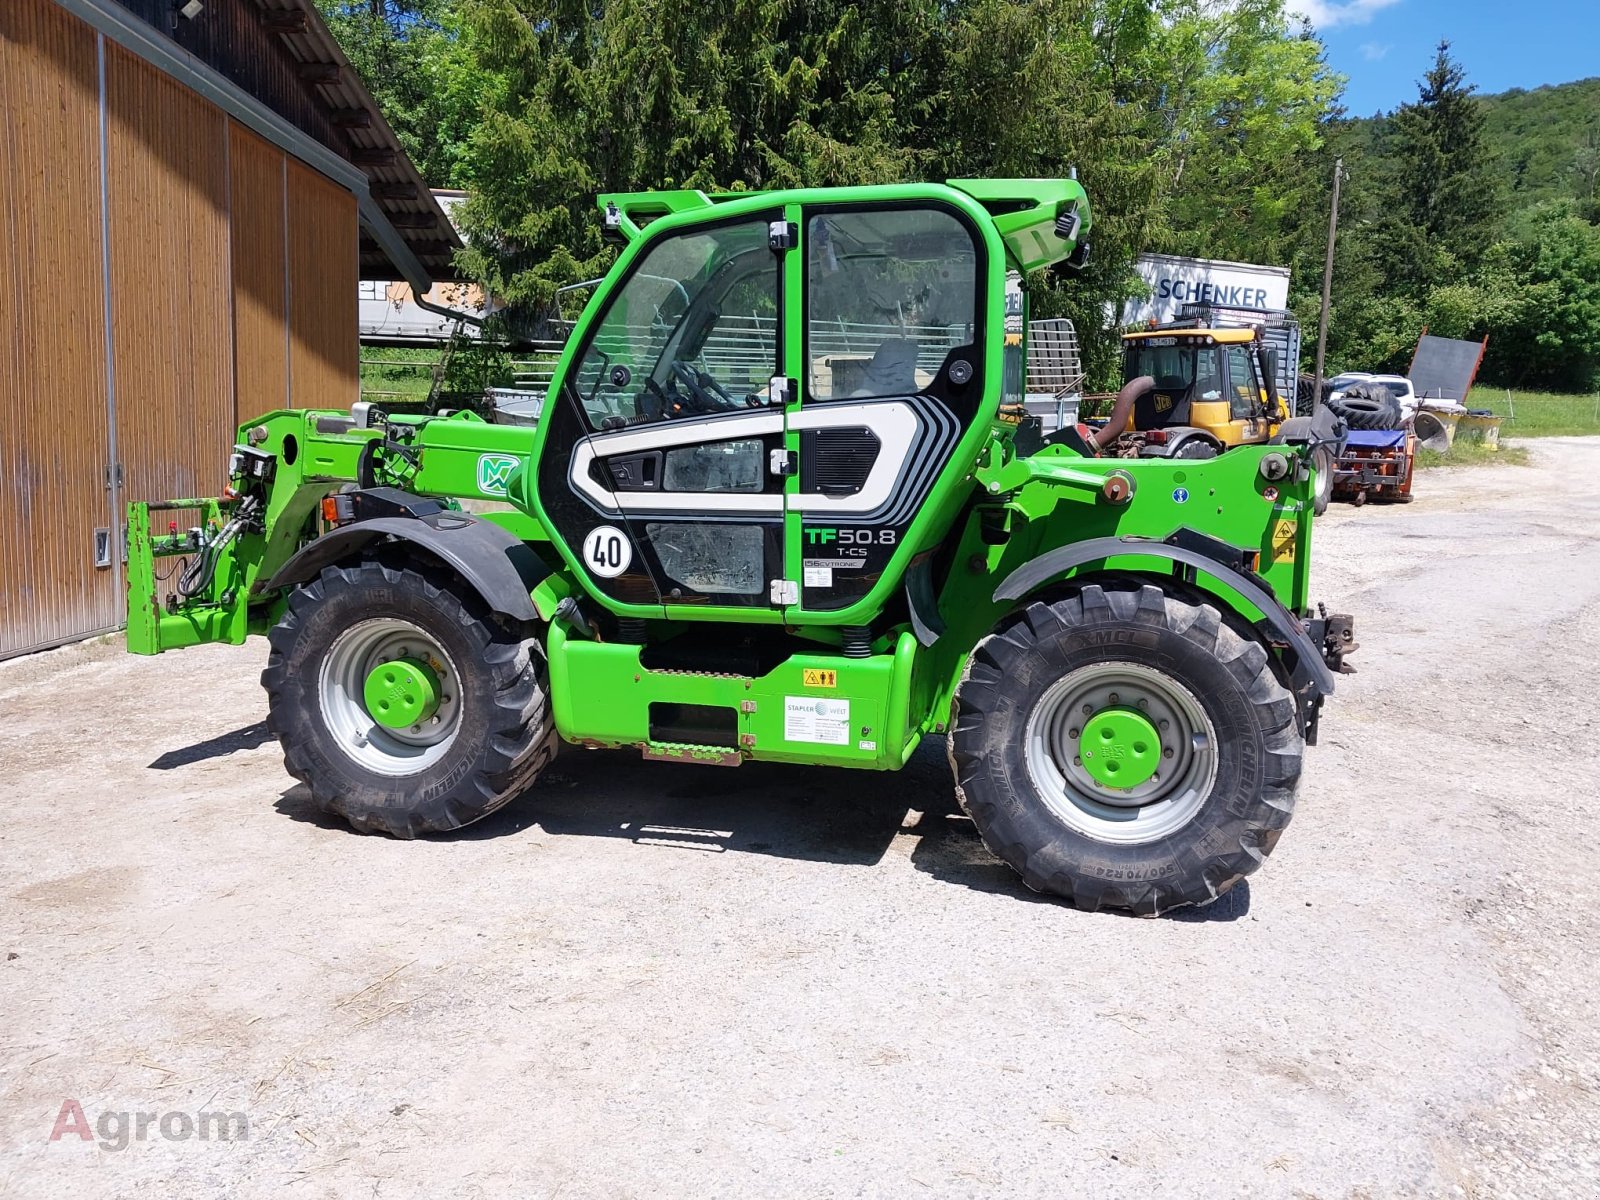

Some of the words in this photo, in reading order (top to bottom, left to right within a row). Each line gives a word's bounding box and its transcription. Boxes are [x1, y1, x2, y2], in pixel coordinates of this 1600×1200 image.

[1159, 279, 1267, 308] SCHENKER
[1154, 394, 1172, 412] JCB
[804, 528, 896, 544] TF50.8
[593, 535, 621, 568] 40
[837, 548, 867, 556] T-CS
[787, 704, 814, 712] STAPLER
[421, 742, 482, 802] MICHELIN
[1229, 711, 1257, 814] MICHELIN
